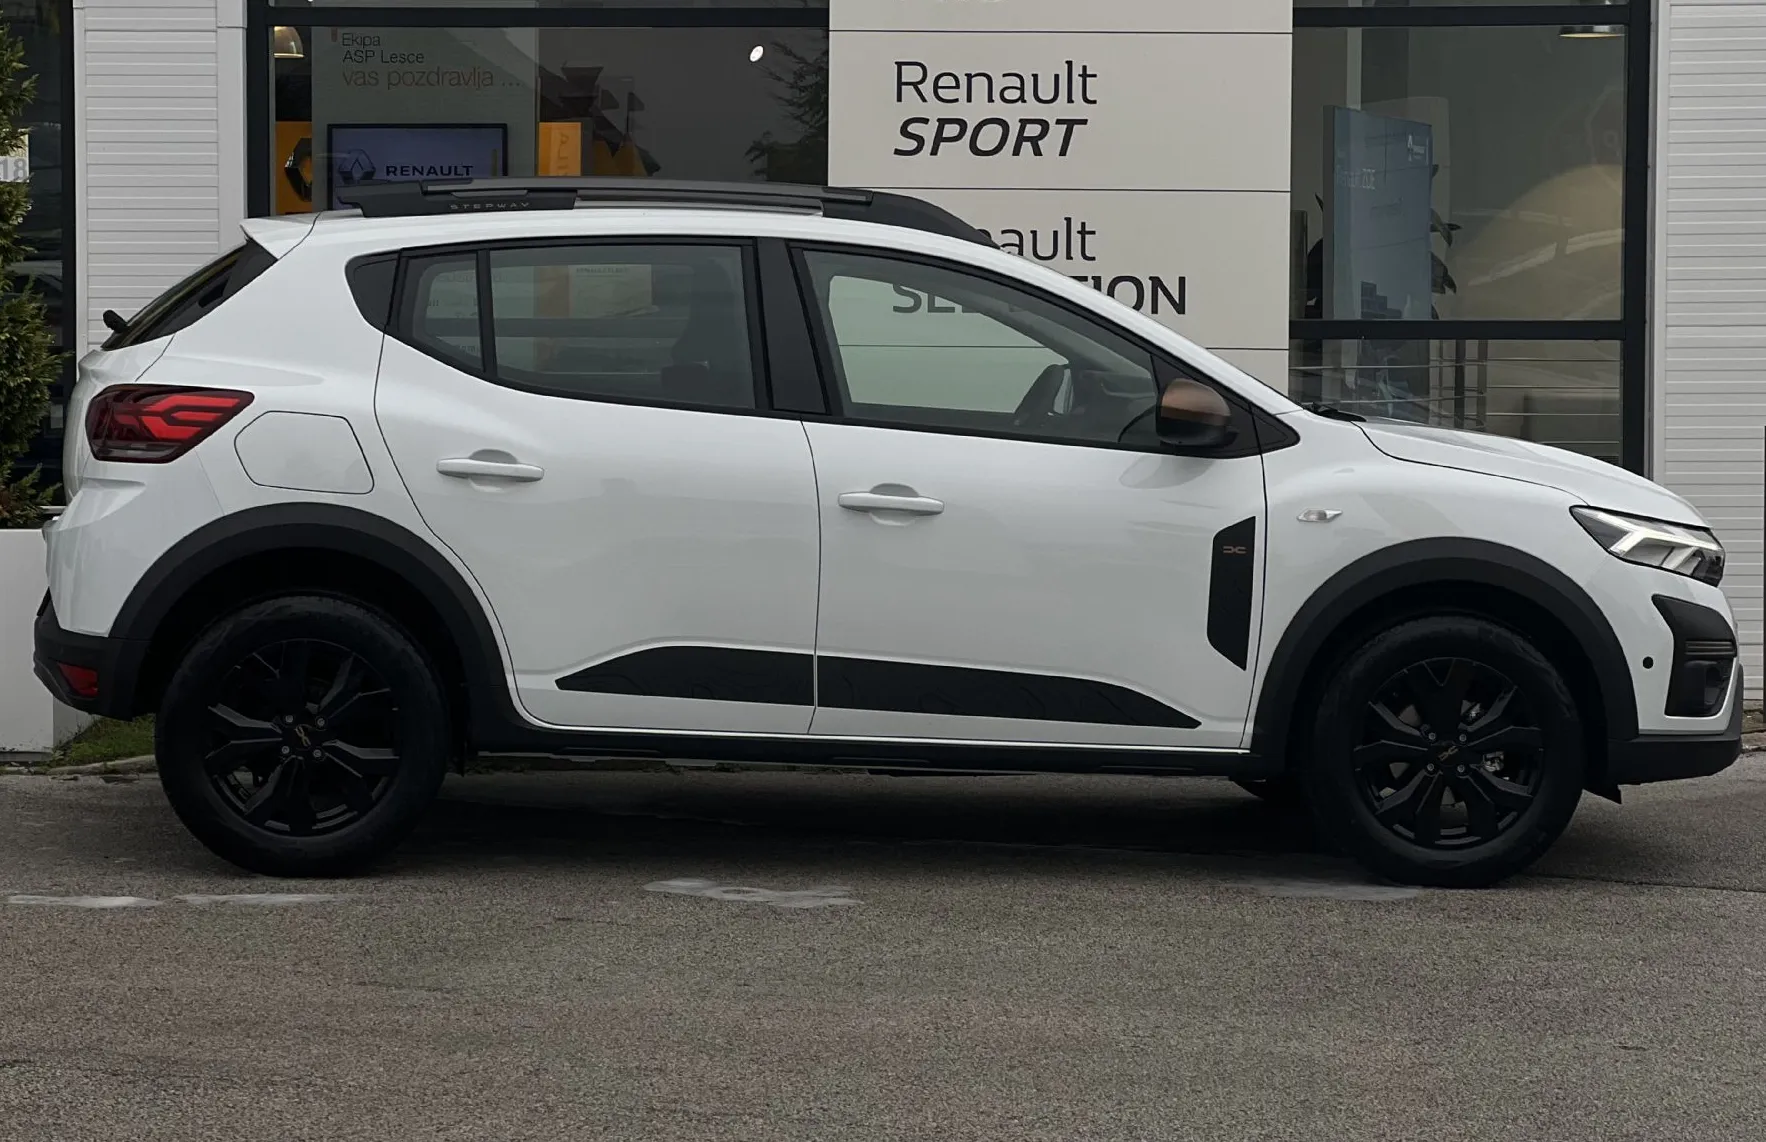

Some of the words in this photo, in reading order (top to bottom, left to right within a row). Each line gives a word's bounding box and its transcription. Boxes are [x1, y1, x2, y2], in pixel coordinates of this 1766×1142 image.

[342, 33, 380, 48] Ekipa
[342, 50, 375, 64] ASP
[381, 51, 424, 64] Lesce
[342, 70, 379, 86] vas
[387, 66, 494, 90] pozdravlja
[894, 60, 1098, 104] Renault
[893, 117, 1088, 157] SPORT
[386, 165, 473, 177] RENAULT
[975, 217, 1097, 261] ault
